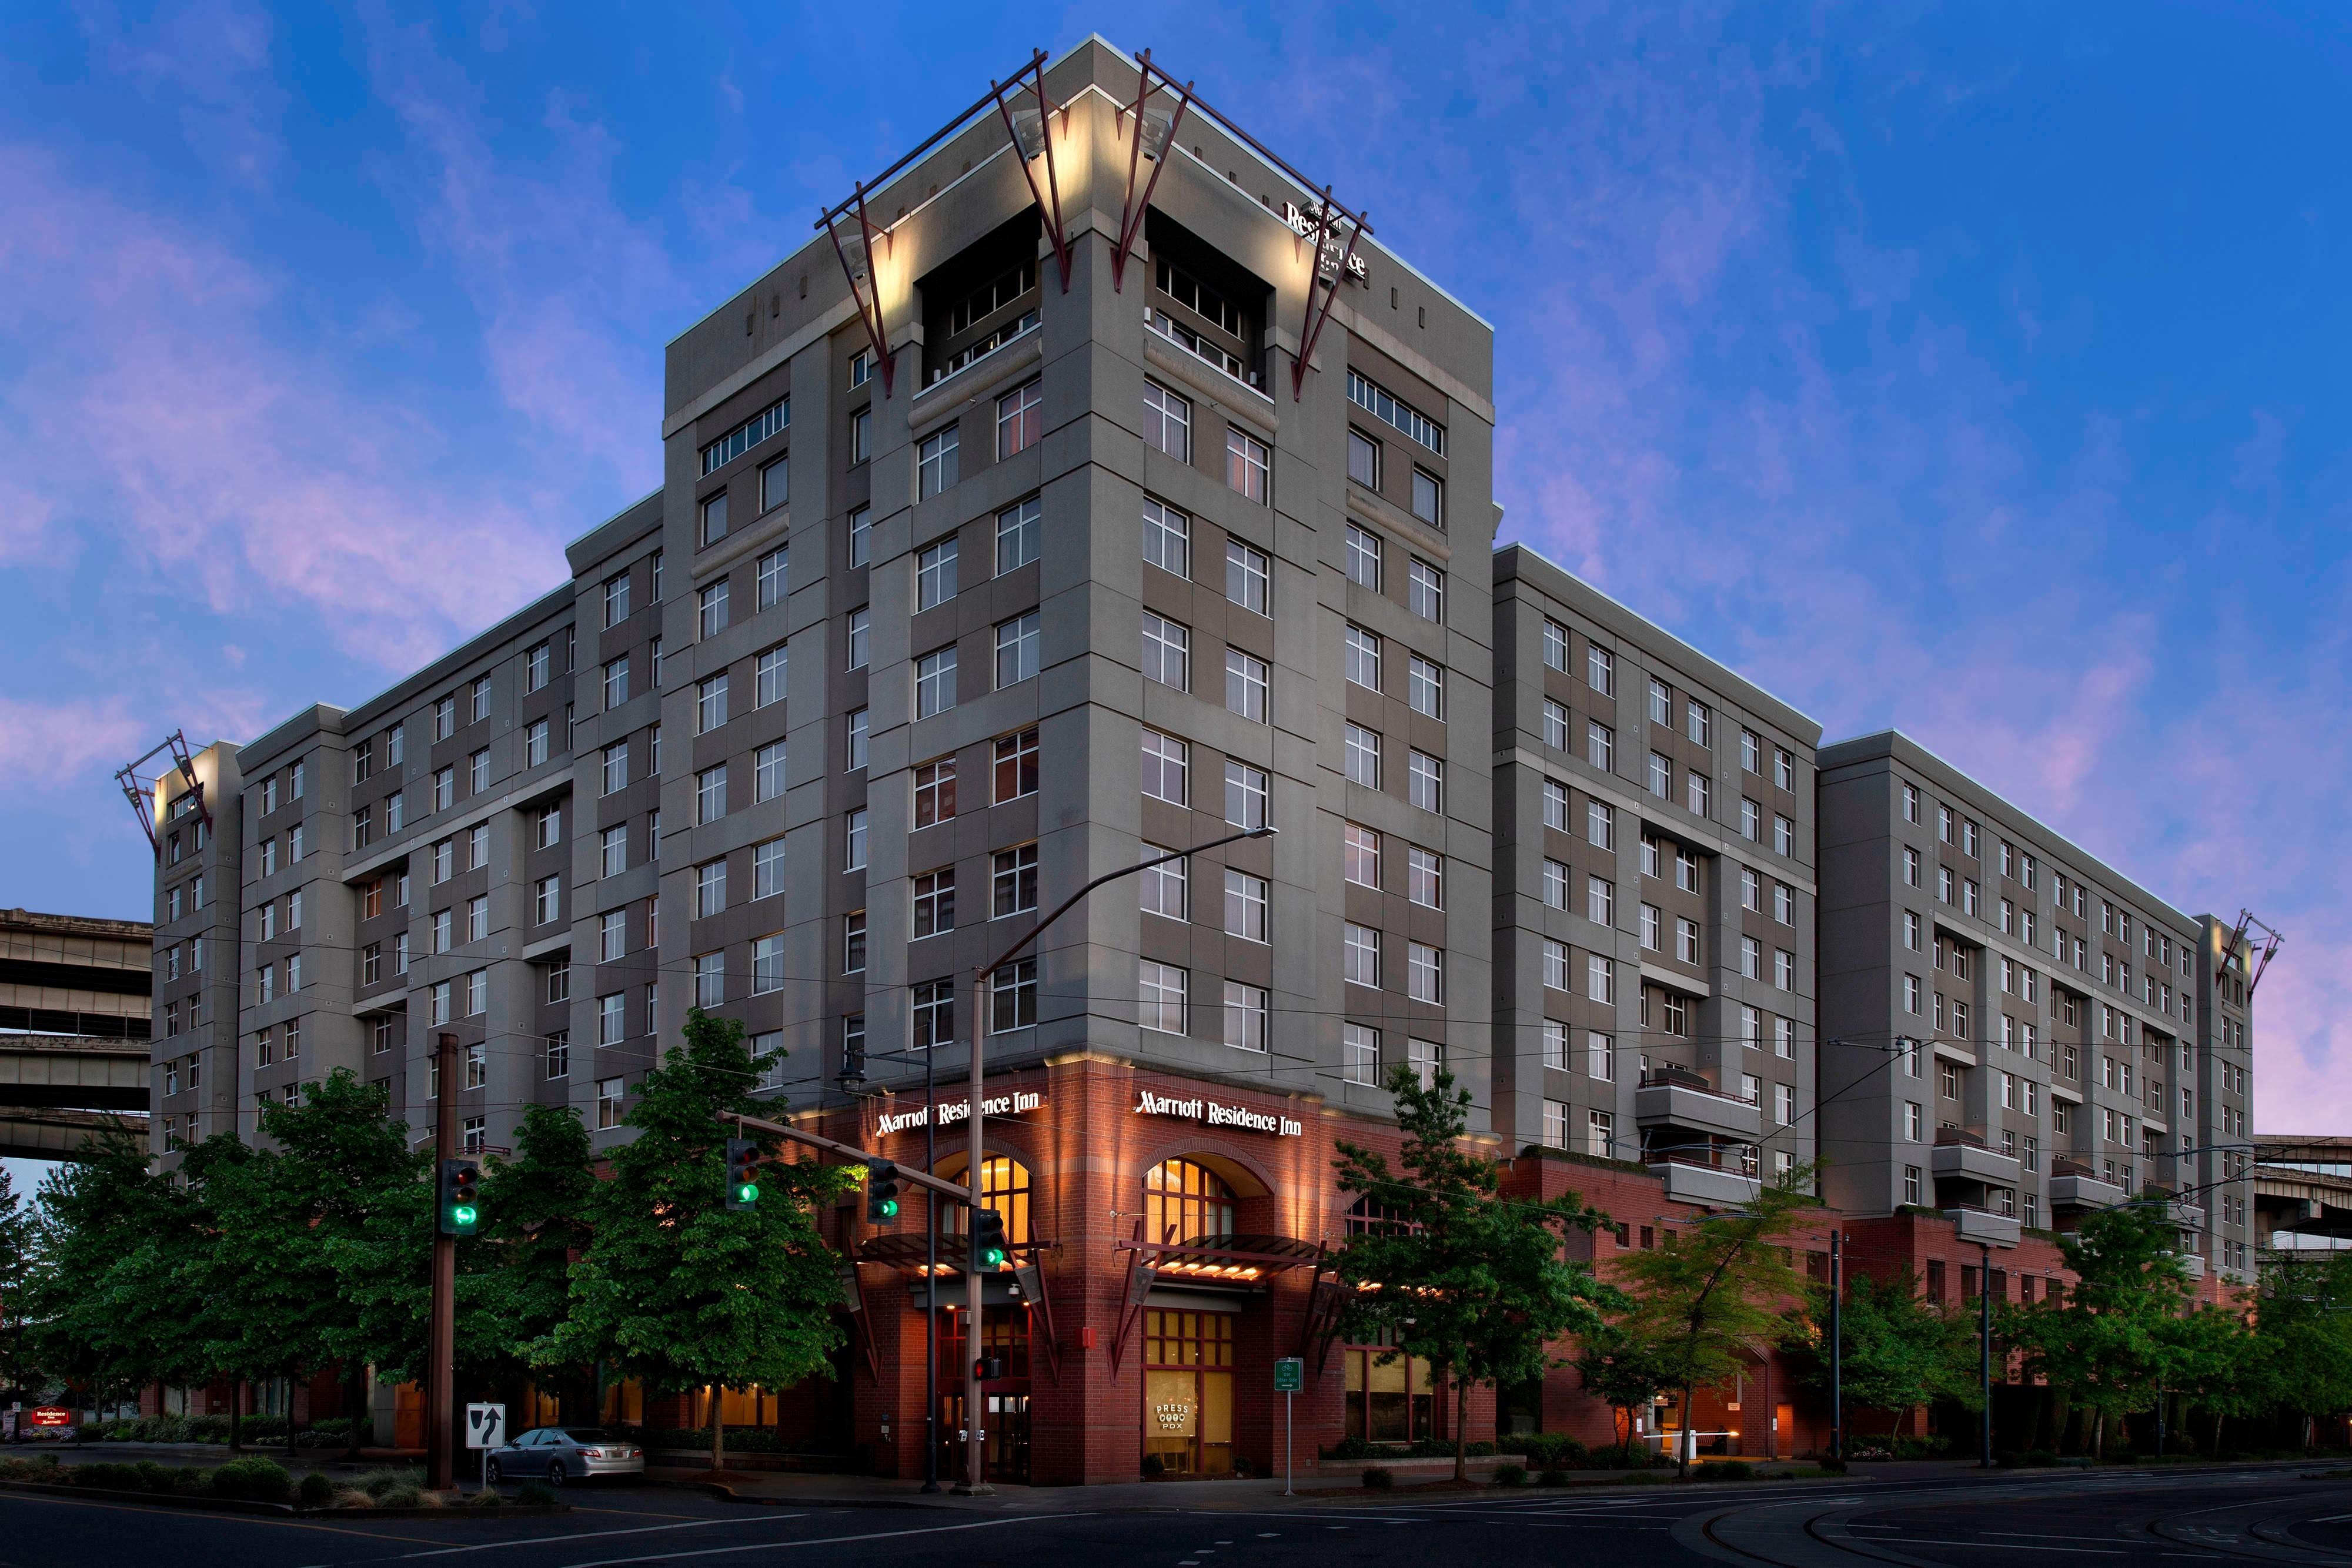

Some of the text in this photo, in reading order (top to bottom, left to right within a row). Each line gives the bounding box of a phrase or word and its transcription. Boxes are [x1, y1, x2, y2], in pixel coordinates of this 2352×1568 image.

[876, 1091, 1039, 1138] Marriot Resience Inn
[1135, 1090, 1302, 1136] Marriott Residence Inn
[1157, 1404, 1188, 1414] PRESS
